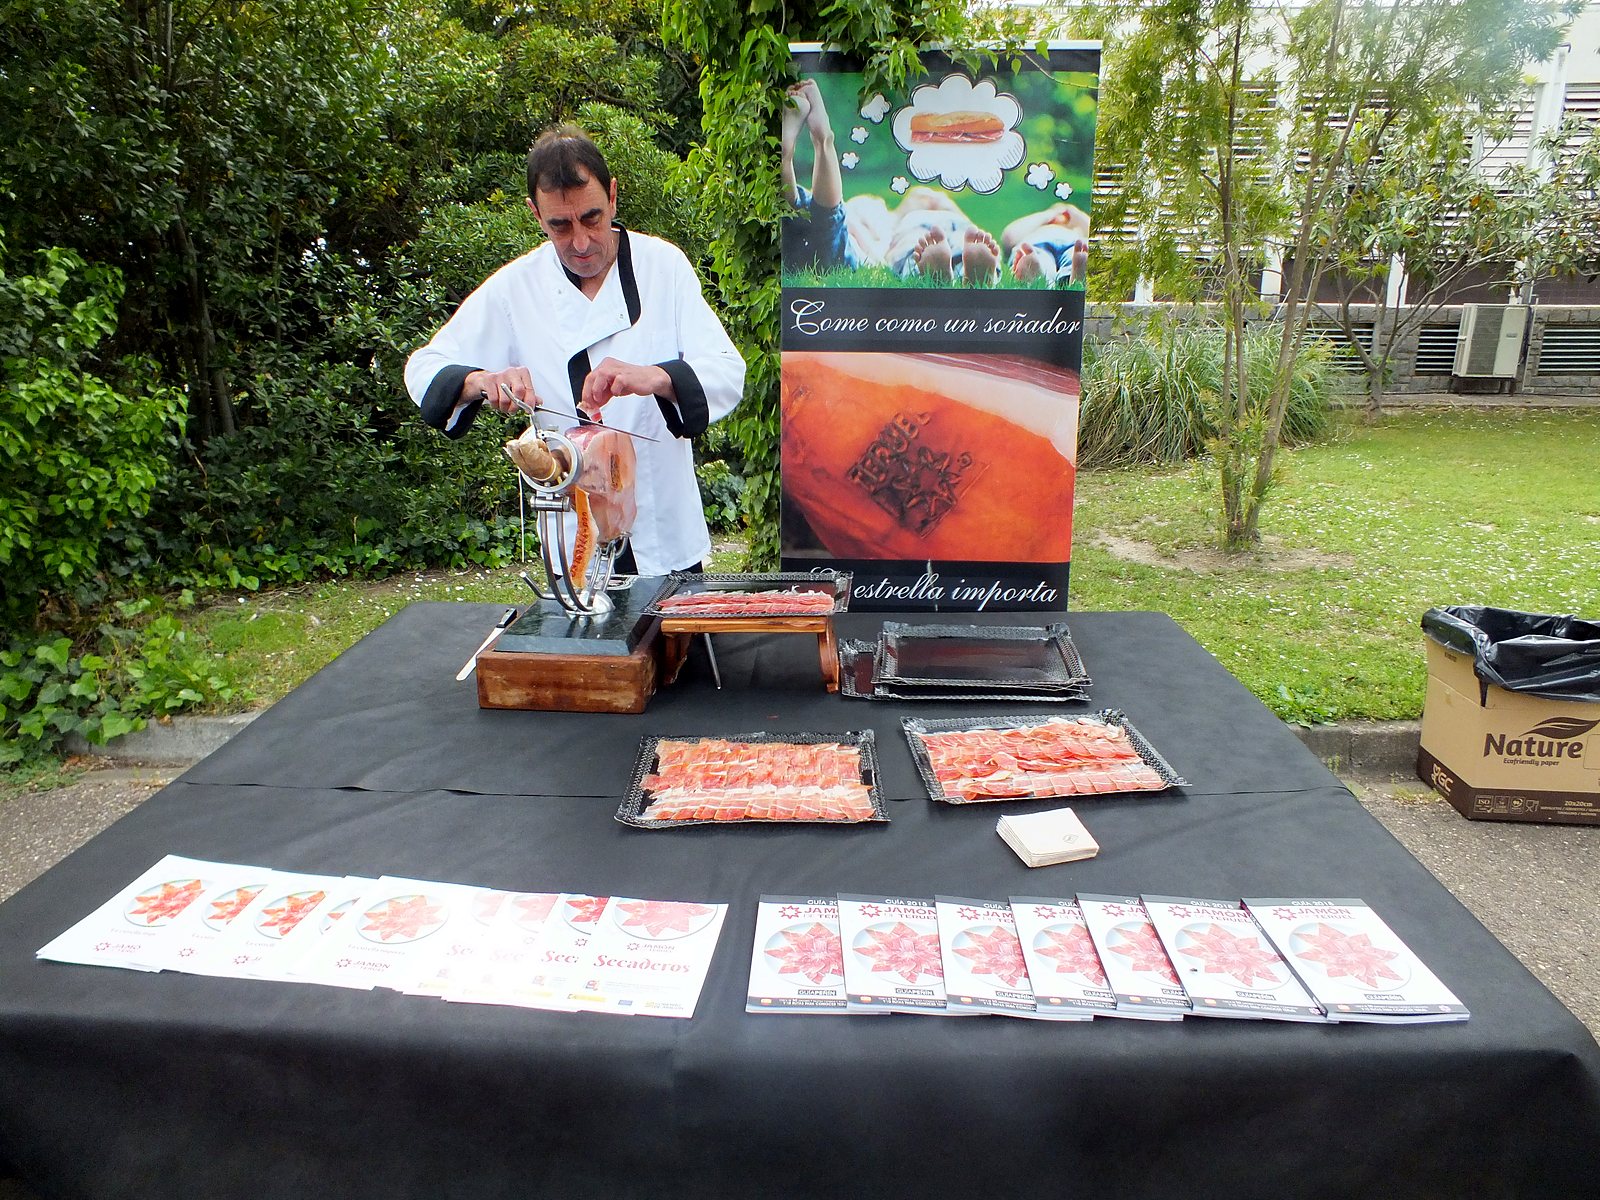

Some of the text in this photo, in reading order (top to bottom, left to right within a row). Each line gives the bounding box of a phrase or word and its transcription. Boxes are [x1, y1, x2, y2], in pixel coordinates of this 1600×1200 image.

[790, 299, 1080, 335] Come como un soñador
[853, 573, 1058, 611] estrella importa
[1483, 733, 1583, 759] Nature
[1503, 758, 1539, 767] Ecofriendly
[593, 954, 691, 974] Secaderos
